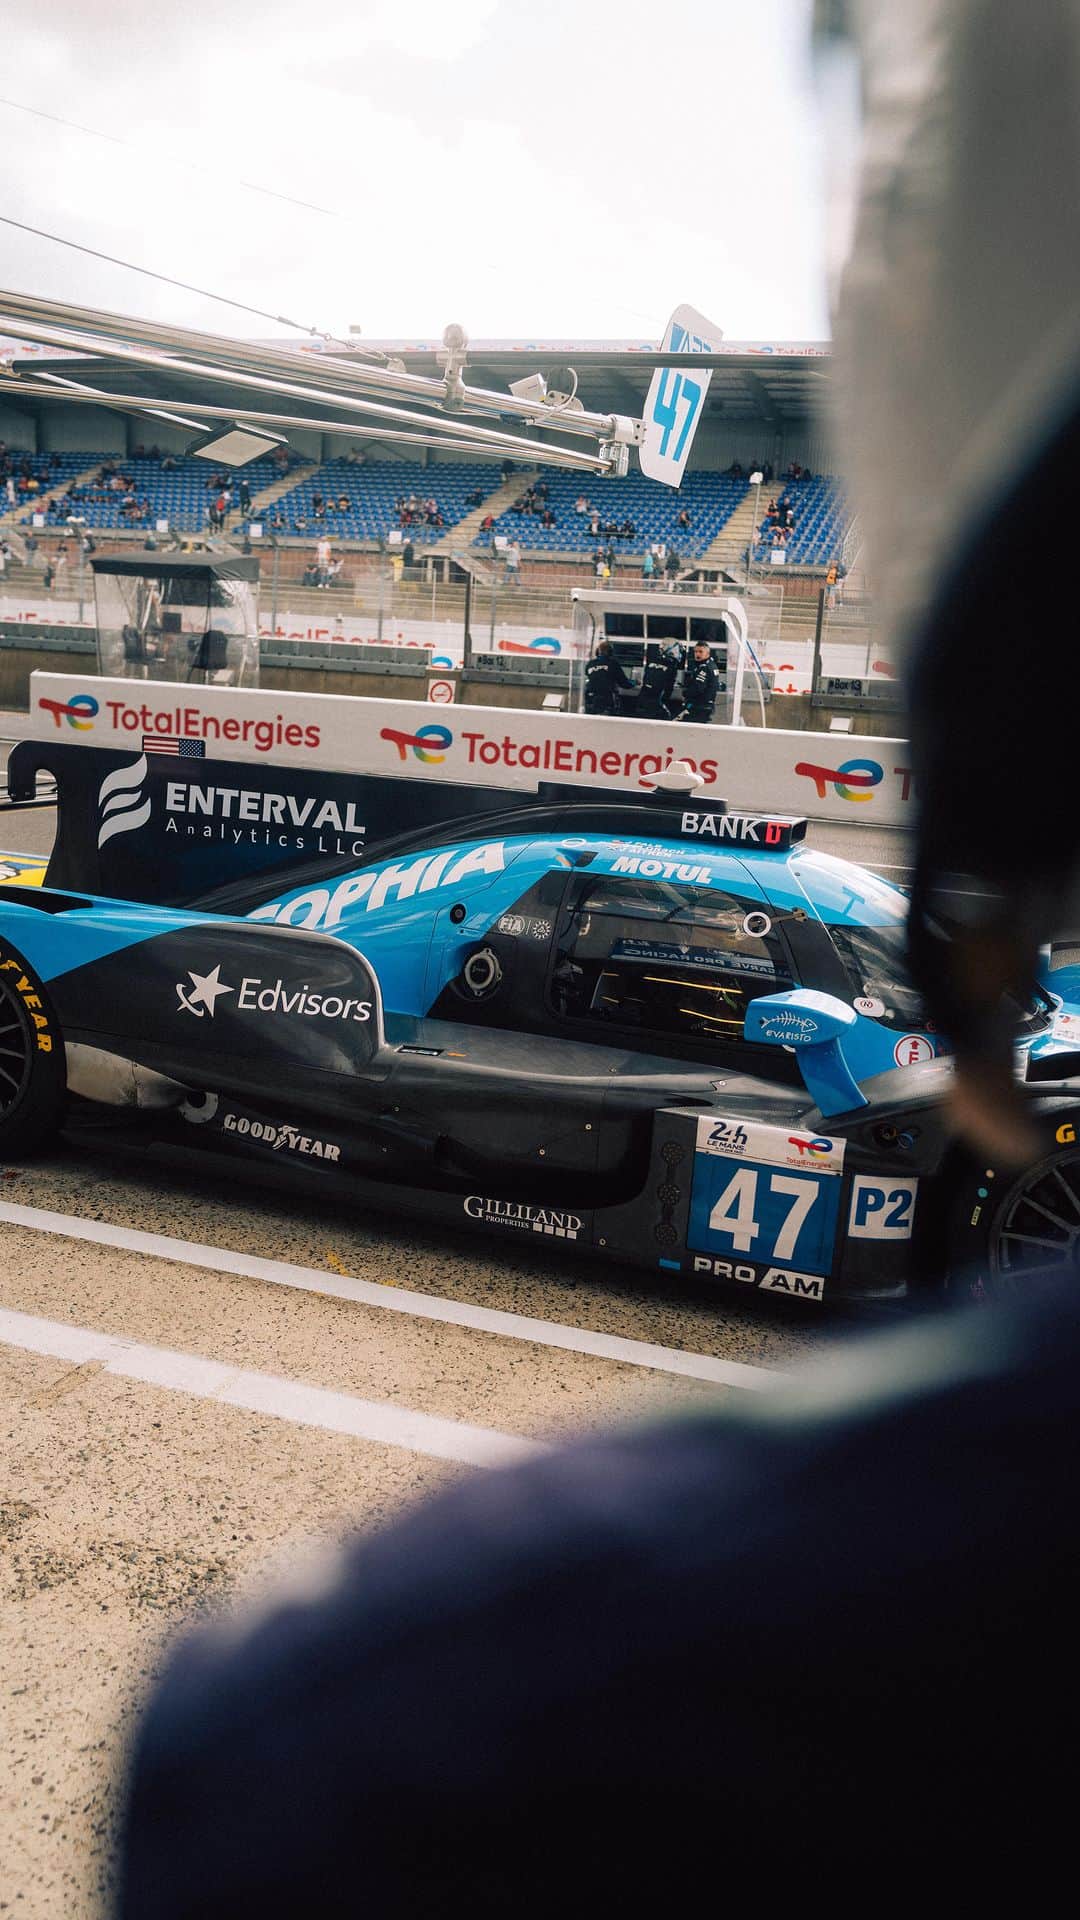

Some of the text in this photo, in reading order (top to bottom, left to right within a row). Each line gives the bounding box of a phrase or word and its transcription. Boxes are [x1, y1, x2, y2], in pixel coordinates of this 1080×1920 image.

[106, 701, 321, 752] TotalEnergies
[165, 781, 366, 834] ENTERVAL
[165, 817, 366, 857] Analytics LLC
[609, 856, 713, 884] MOTUL
[500, 917, 523, 932] FIA
[238, 977, 373, 1022] Edvisors
[706, 1139, 717, 1147] LE
[718, 1142, 746, 1151] MANS
[786, 1156, 832, 1169] TotalEnergies
[463, 1195, 582, 1231] GILLILAND
[485, 1215, 529, 1229] PROPERTIES
[709, 1168, 820, 1260] 47
[854, 1186, 914, 1229] P2
[693, 1256, 820, 1297] PRO AM
